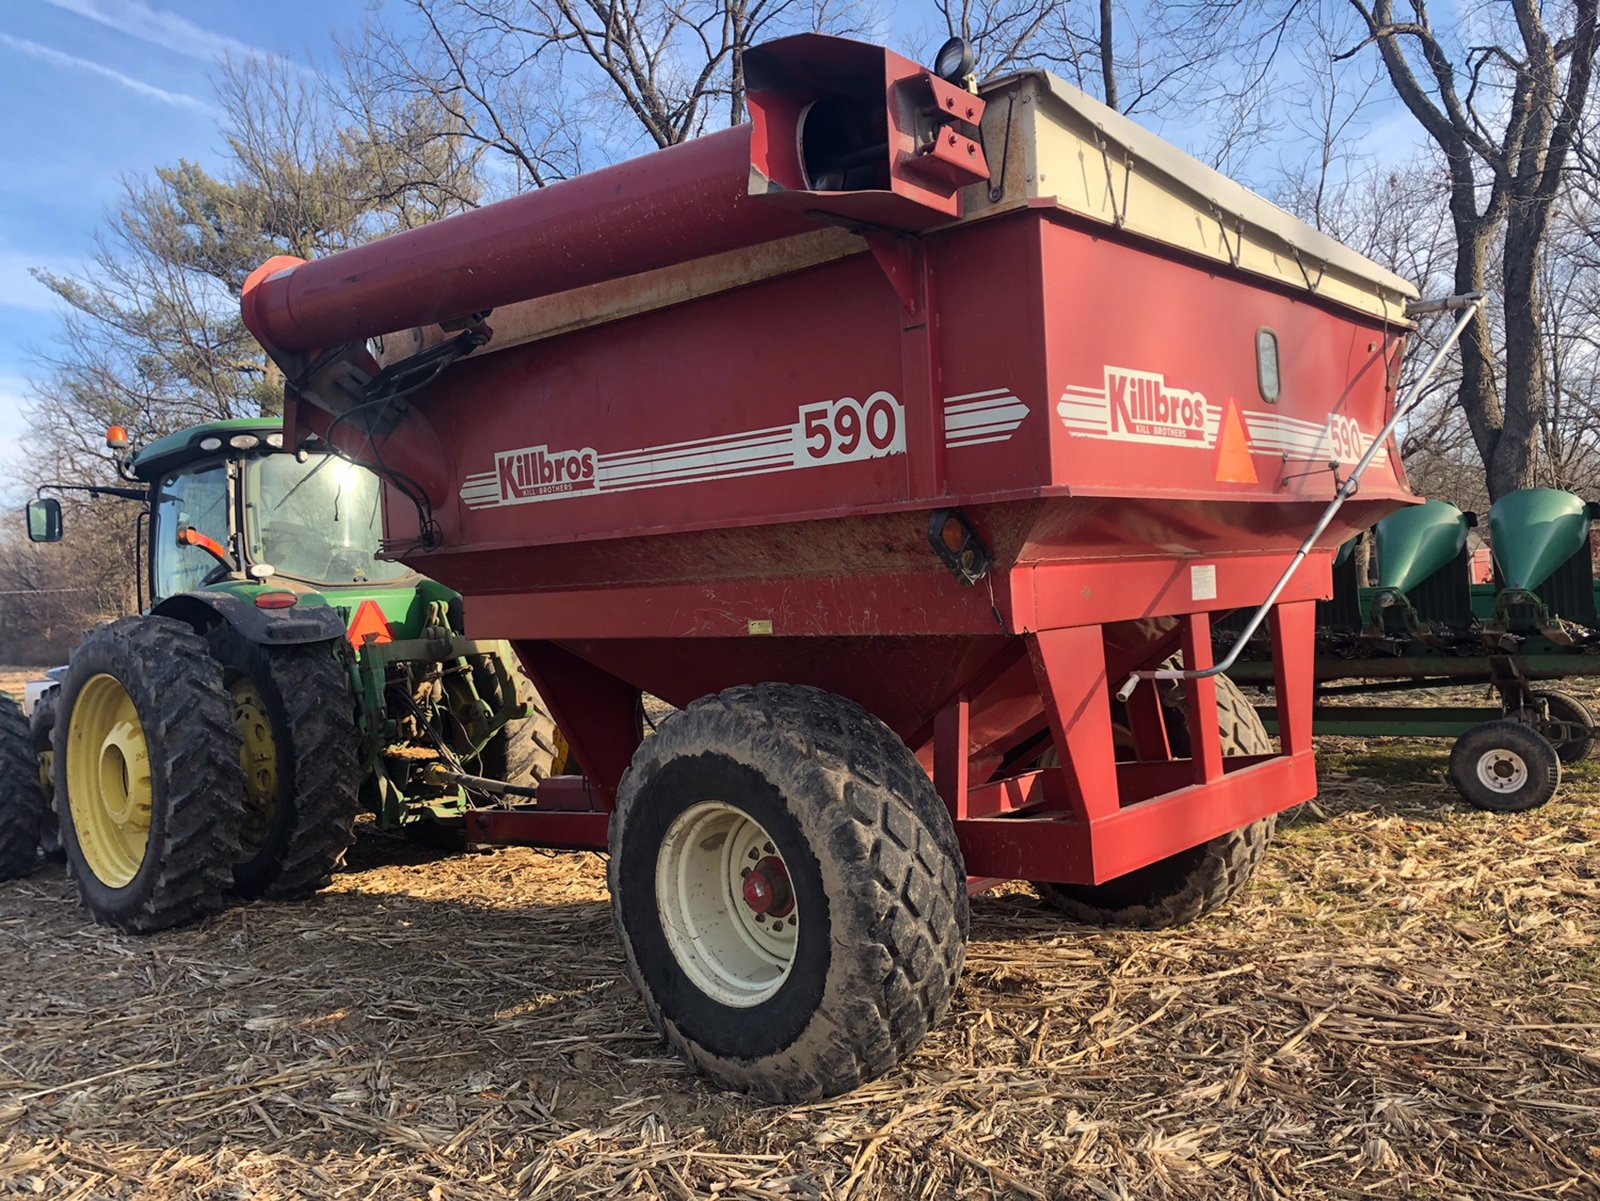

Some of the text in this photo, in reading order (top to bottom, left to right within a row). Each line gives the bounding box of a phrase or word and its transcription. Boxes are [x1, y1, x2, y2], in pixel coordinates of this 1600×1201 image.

[1108, 373, 1204, 434] Killbros
[805, 399, 896, 459] 590
[1135, 424, 1187, 438] KILL BROTHERS
[1331, 420, 1361, 460] 590
[498, 451, 594, 500] Killbros
[523, 484, 573, 497] KILL BROTHERS
